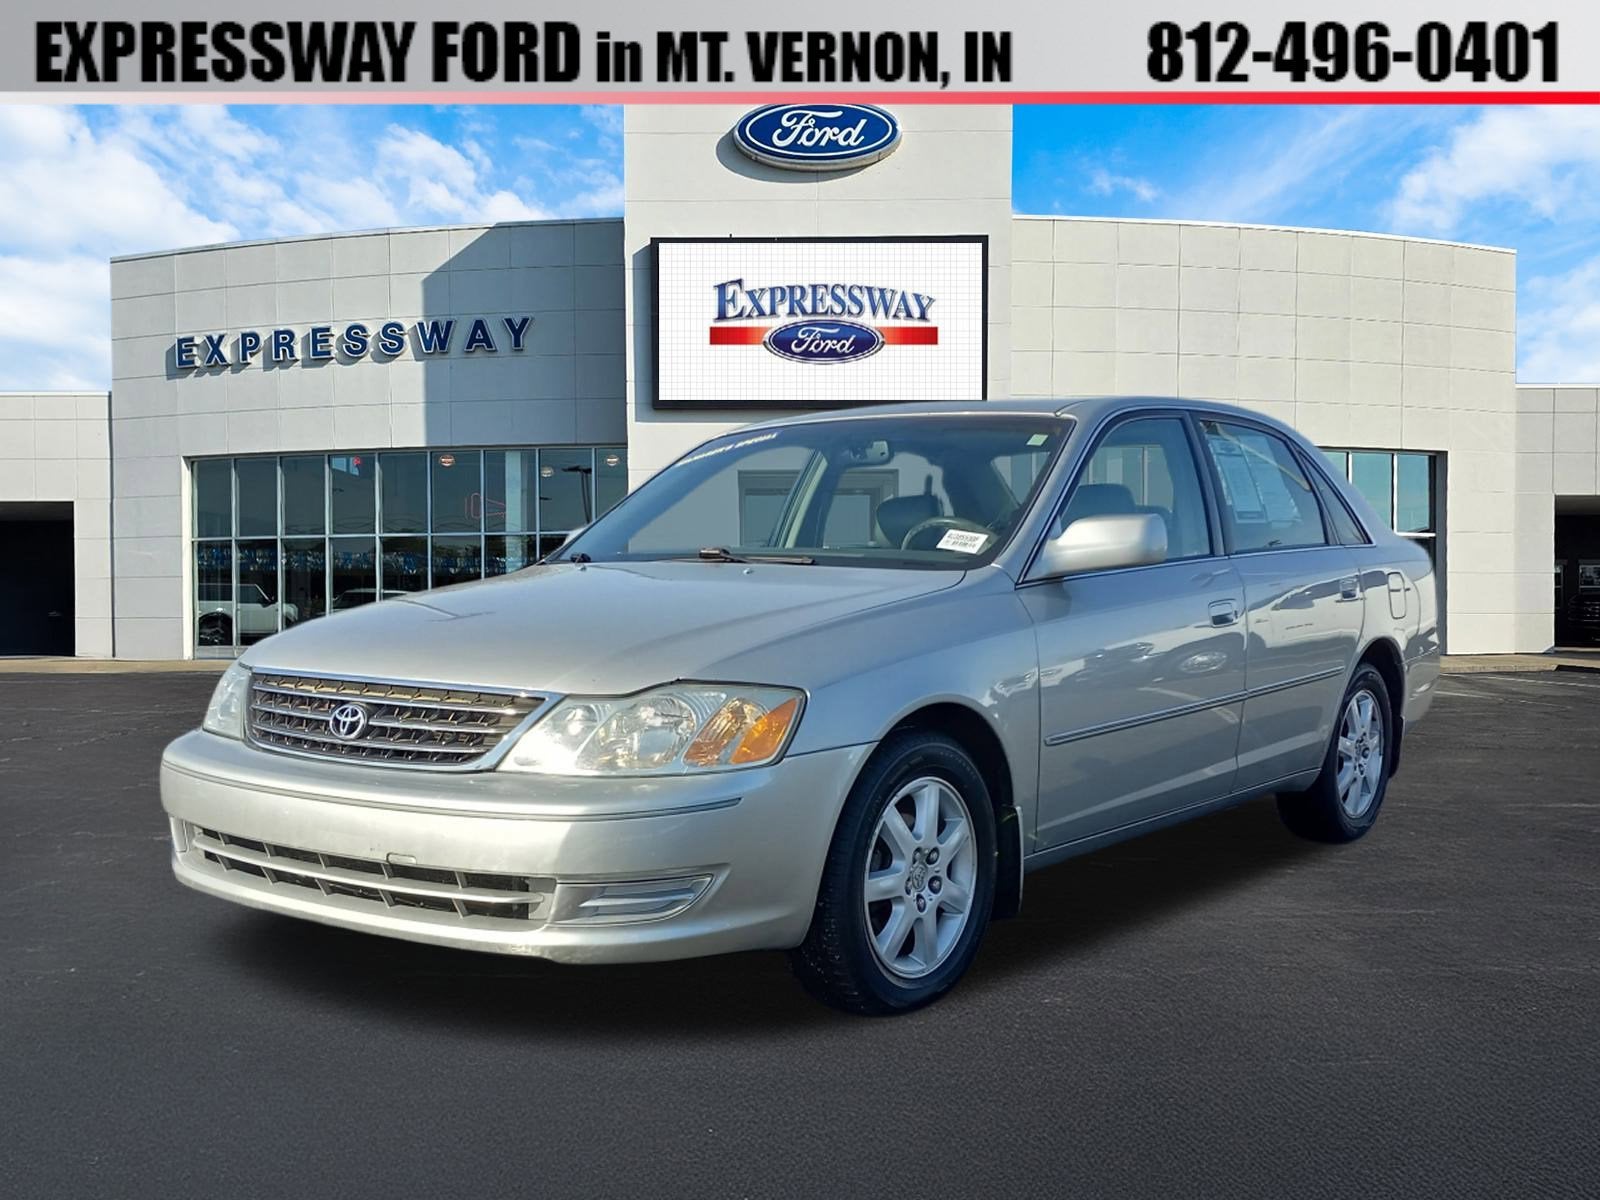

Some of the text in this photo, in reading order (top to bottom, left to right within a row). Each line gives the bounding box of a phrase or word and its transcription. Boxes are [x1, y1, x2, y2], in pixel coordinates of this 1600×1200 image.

[772, 109, 868, 147] Ford
[175, 316, 532, 370] EXPRESSWAY
[790, 326, 855, 354] Ford
